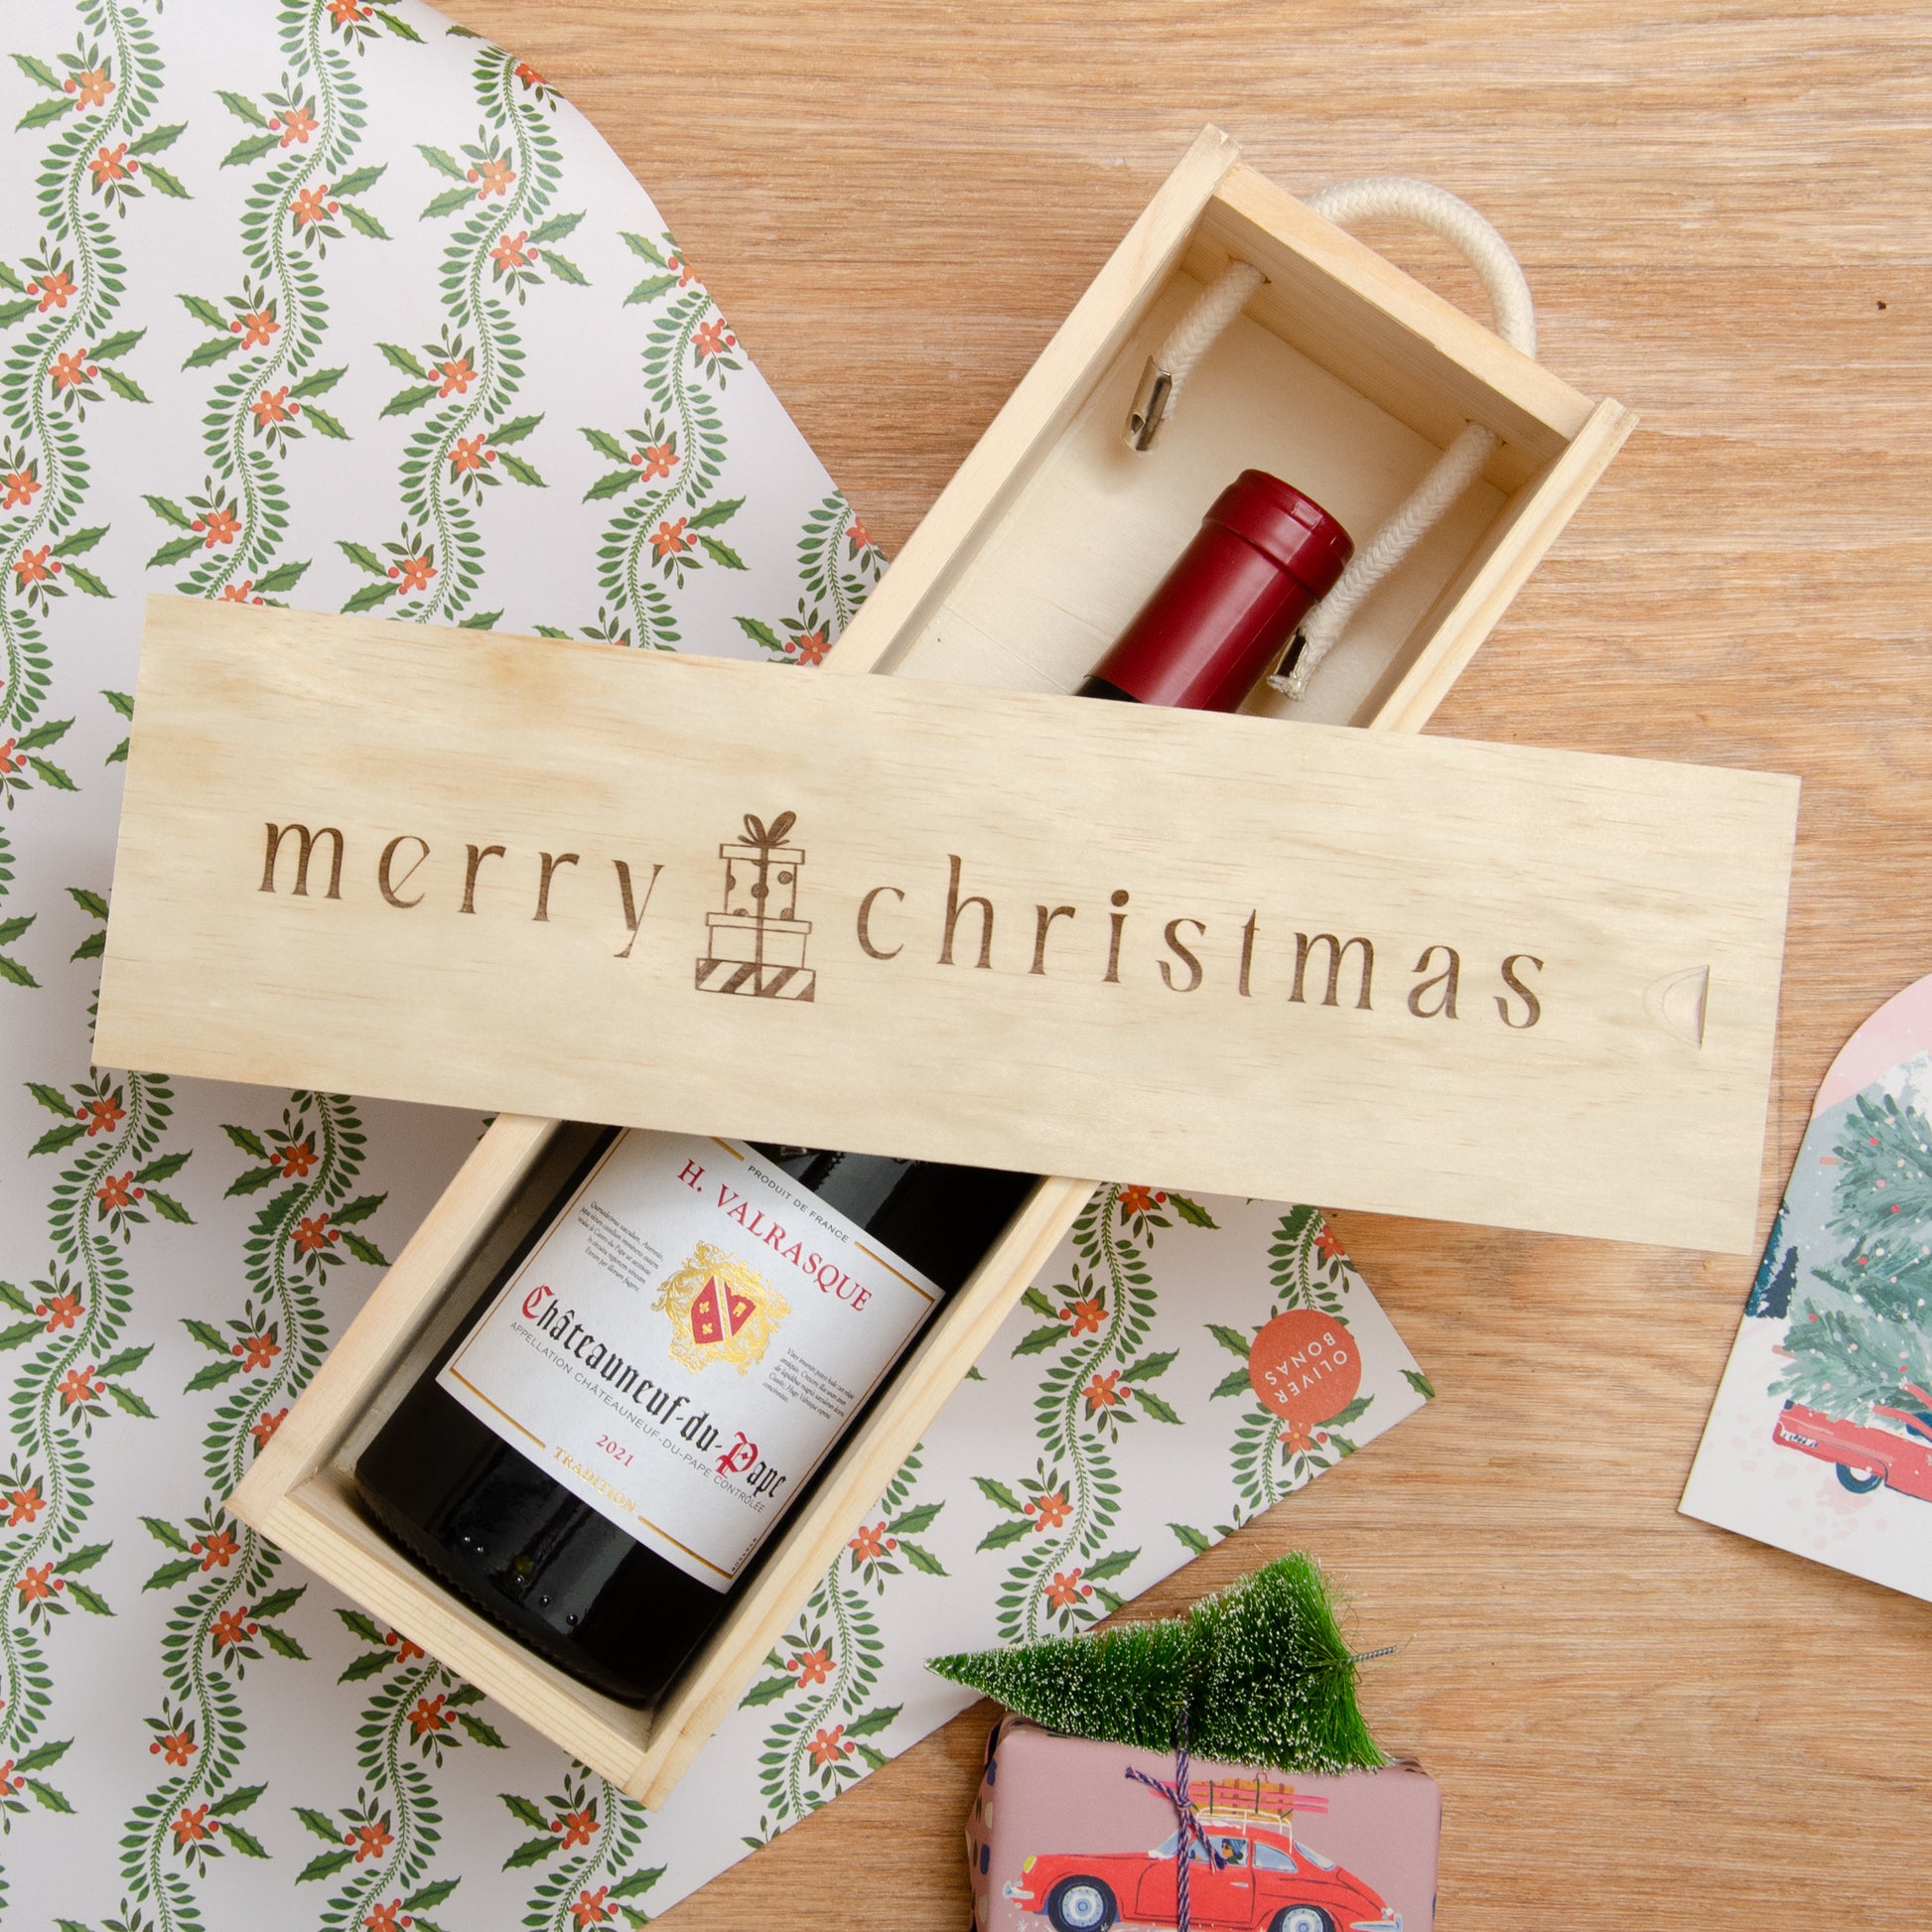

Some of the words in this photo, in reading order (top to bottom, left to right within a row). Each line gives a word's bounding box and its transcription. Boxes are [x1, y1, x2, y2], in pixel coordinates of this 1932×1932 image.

[258, 823, 664, 958] merry
[857, 855, 1544, 1029] christmas
[677, 1158, 704, 1192] H.
[716, 1183, 873, 1312] VALRASQUE
[748, 1165, 792, 1201] PRODUIT
[793, 1197, 809, 1212] DE
[809, 1209, 850, 1243] FRANCE
[521, 1284, 787, 1500] Châteauneuf-du-Pape
[1265, 1331, 1335, 1386] BONAS
[1274, 1350, 1347, 1404] OLIVER
[509, 1321, 573, 1372] APPELLATION
[575, 1373, 713, 1478] CHÂTEAUNEUF-DU-PAPE
[713, 1473, 766, 1514] CONTRÔLÉE
[596, 1434, 635, 1468] 2021
[553, 1447, 637, 1514] TRADITION
